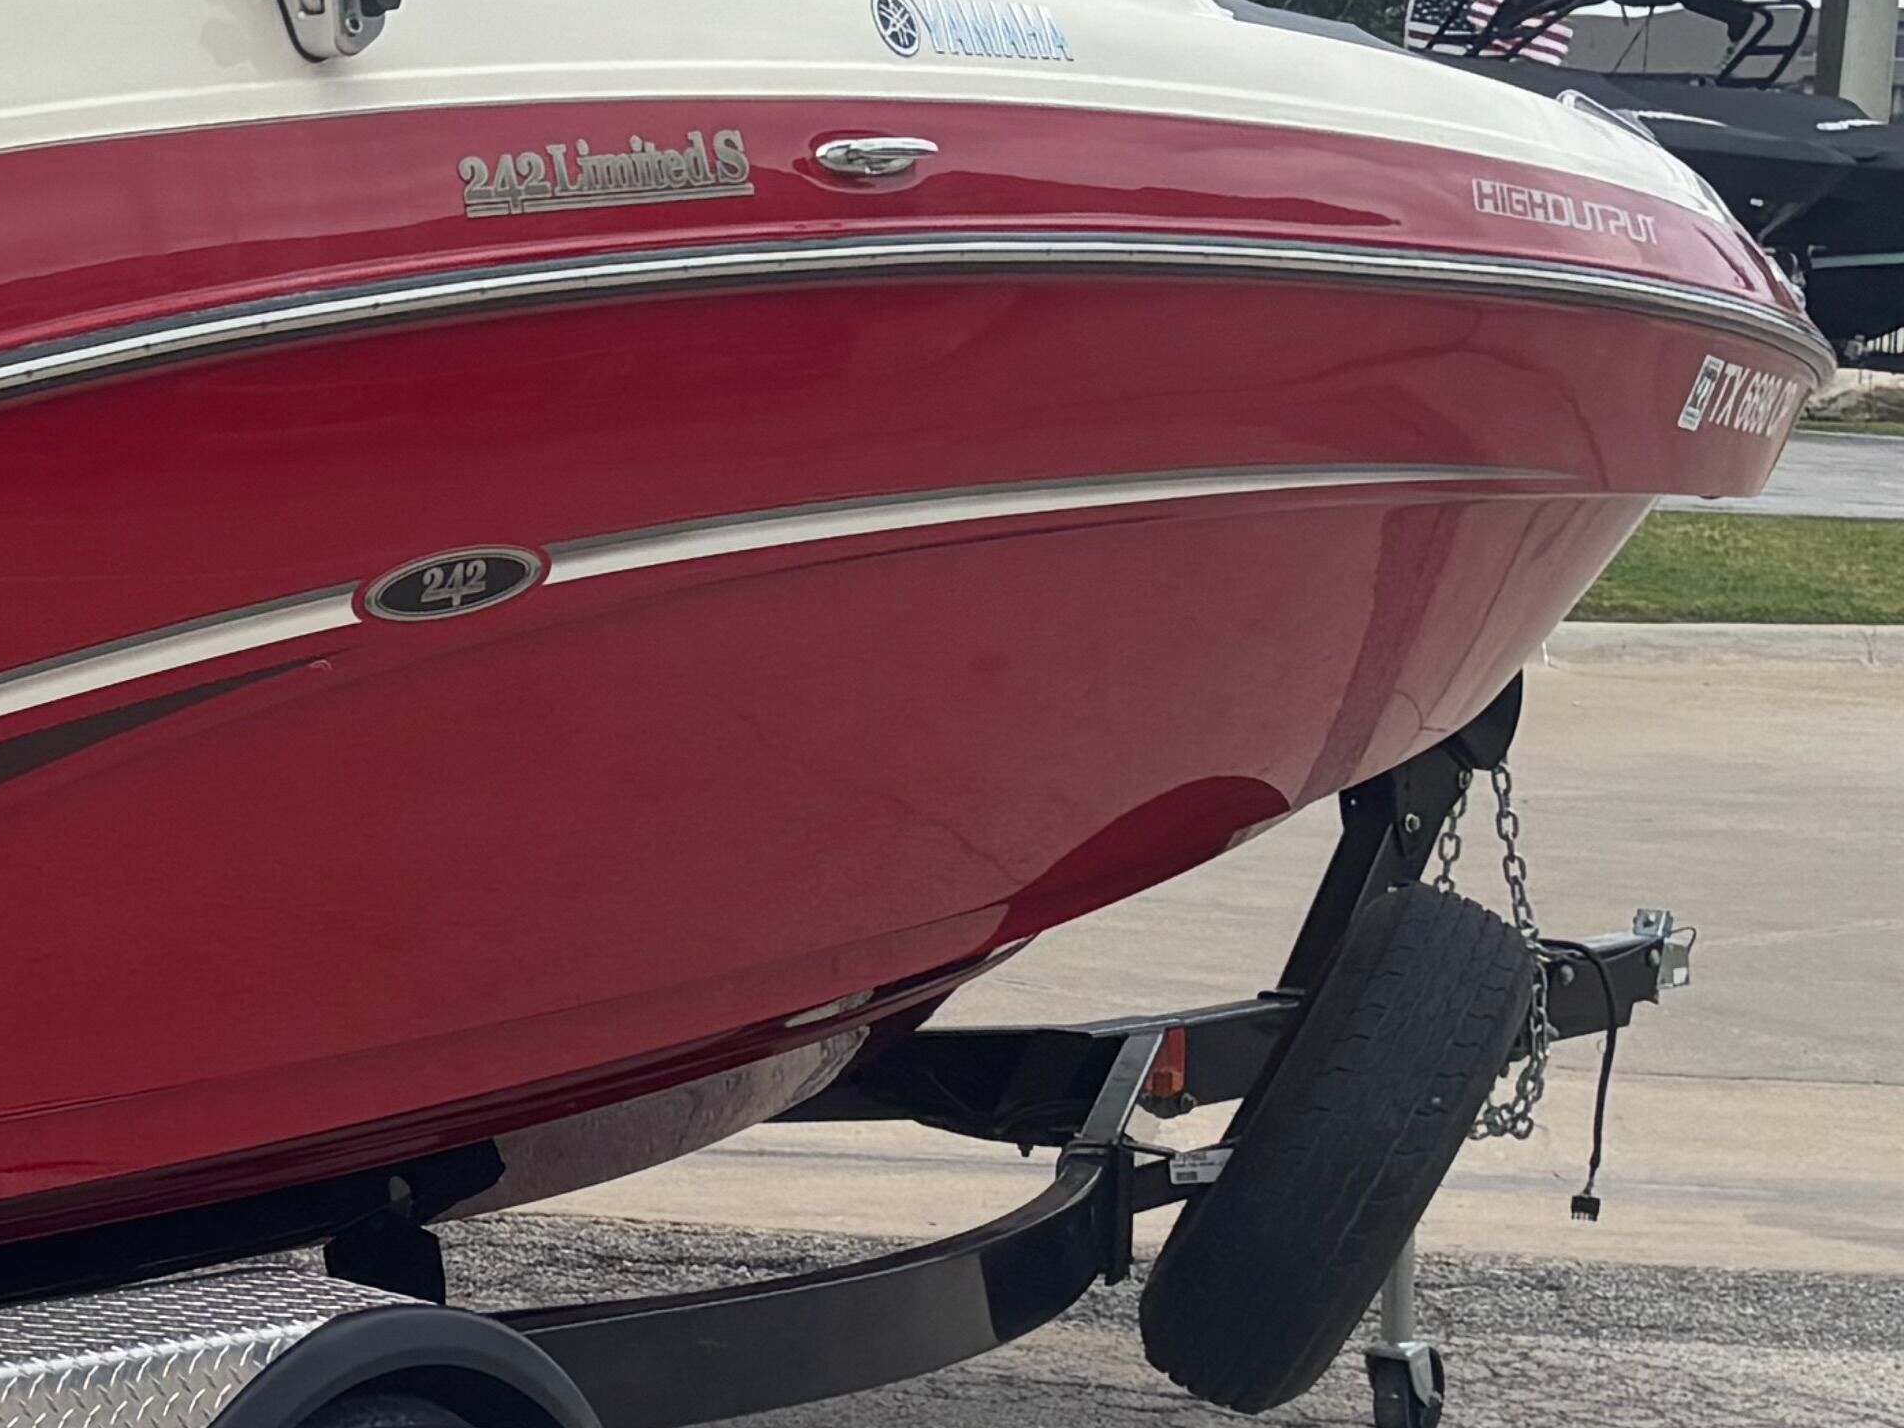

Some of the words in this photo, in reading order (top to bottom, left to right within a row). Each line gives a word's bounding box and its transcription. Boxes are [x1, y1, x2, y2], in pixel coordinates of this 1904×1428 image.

[459, 150, 554, 215] 242
[546, 130, 715, 197] Limited
[713, 129, 750, 185] S
[1707, 362, 1751, 427] TX
[420, 559, 488, 607] 242
